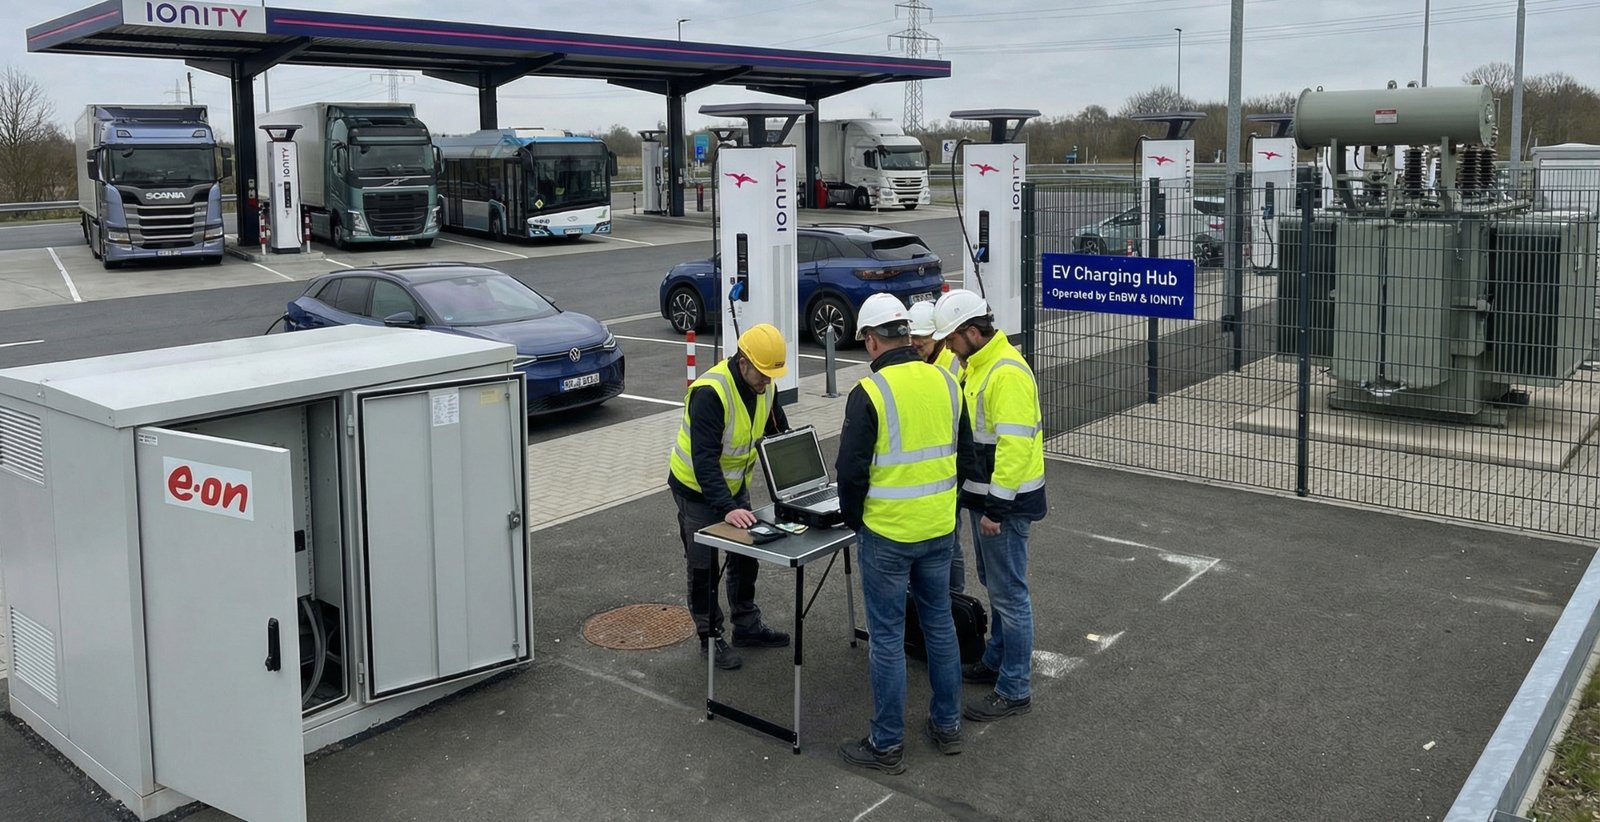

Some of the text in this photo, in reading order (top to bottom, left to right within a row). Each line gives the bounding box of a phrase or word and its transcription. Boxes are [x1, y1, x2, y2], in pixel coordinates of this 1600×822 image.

[147, 2, 248, 28] IONITY
[282, 147, 291, 178] IONITY
[1012, 154, 1020, 210] IONITY
[145, 191, 186, 200] SCANIA
[775, 160, 787, 232] IONITY
[1052, 265, 1178, 288] EV Charging Hub
[1052, 288, 1184, 306] Operated by EnBW & IONITY
